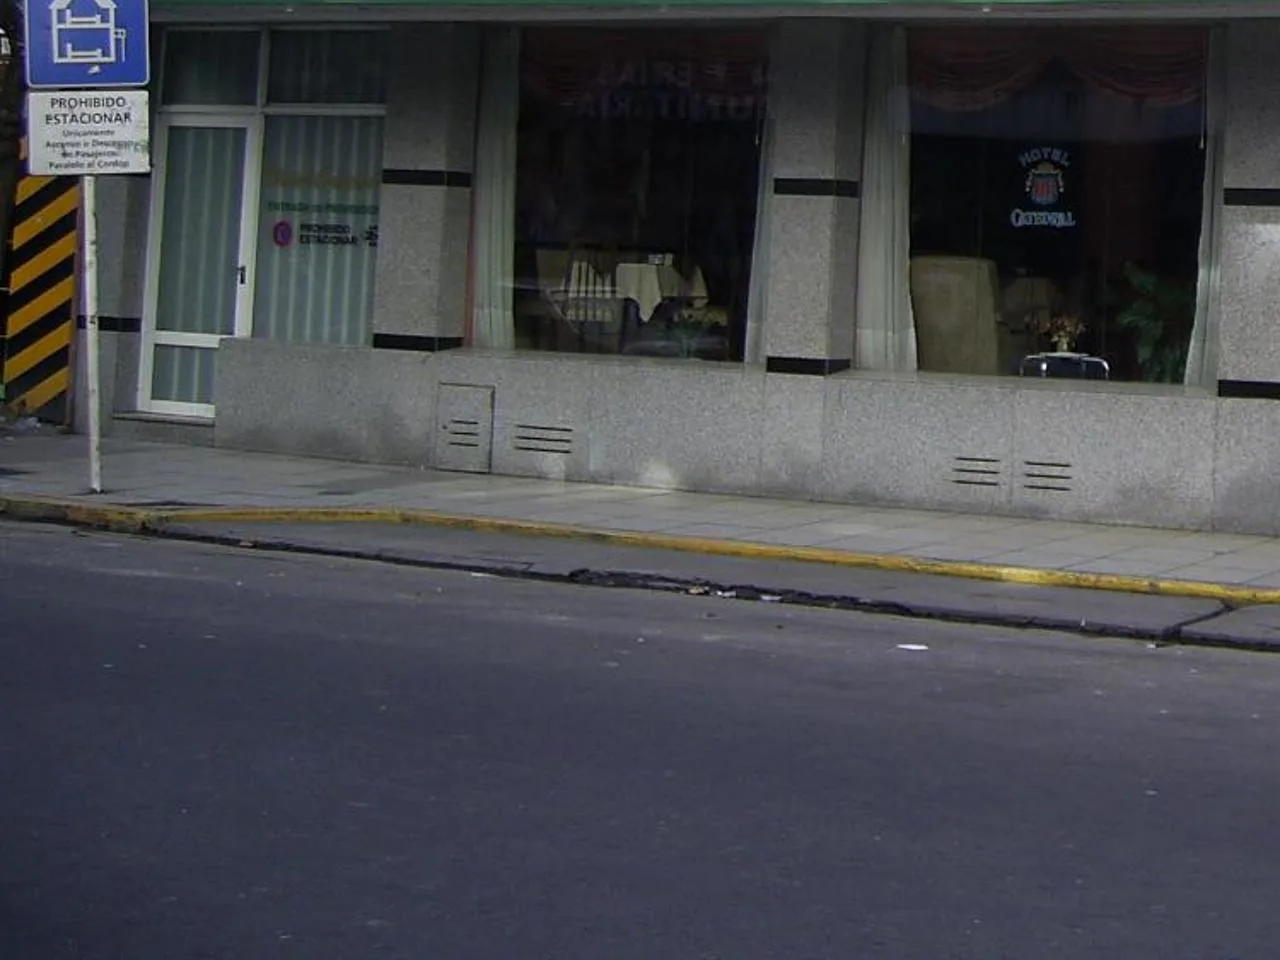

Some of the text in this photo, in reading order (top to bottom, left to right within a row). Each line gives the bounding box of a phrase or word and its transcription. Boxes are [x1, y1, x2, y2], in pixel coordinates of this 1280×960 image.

[50, 96, 126, 109] PROHIBIDO
[45, 112, 133, 125] ESTACIONAR
[1019, 147, 1070, 167] HOTEL
